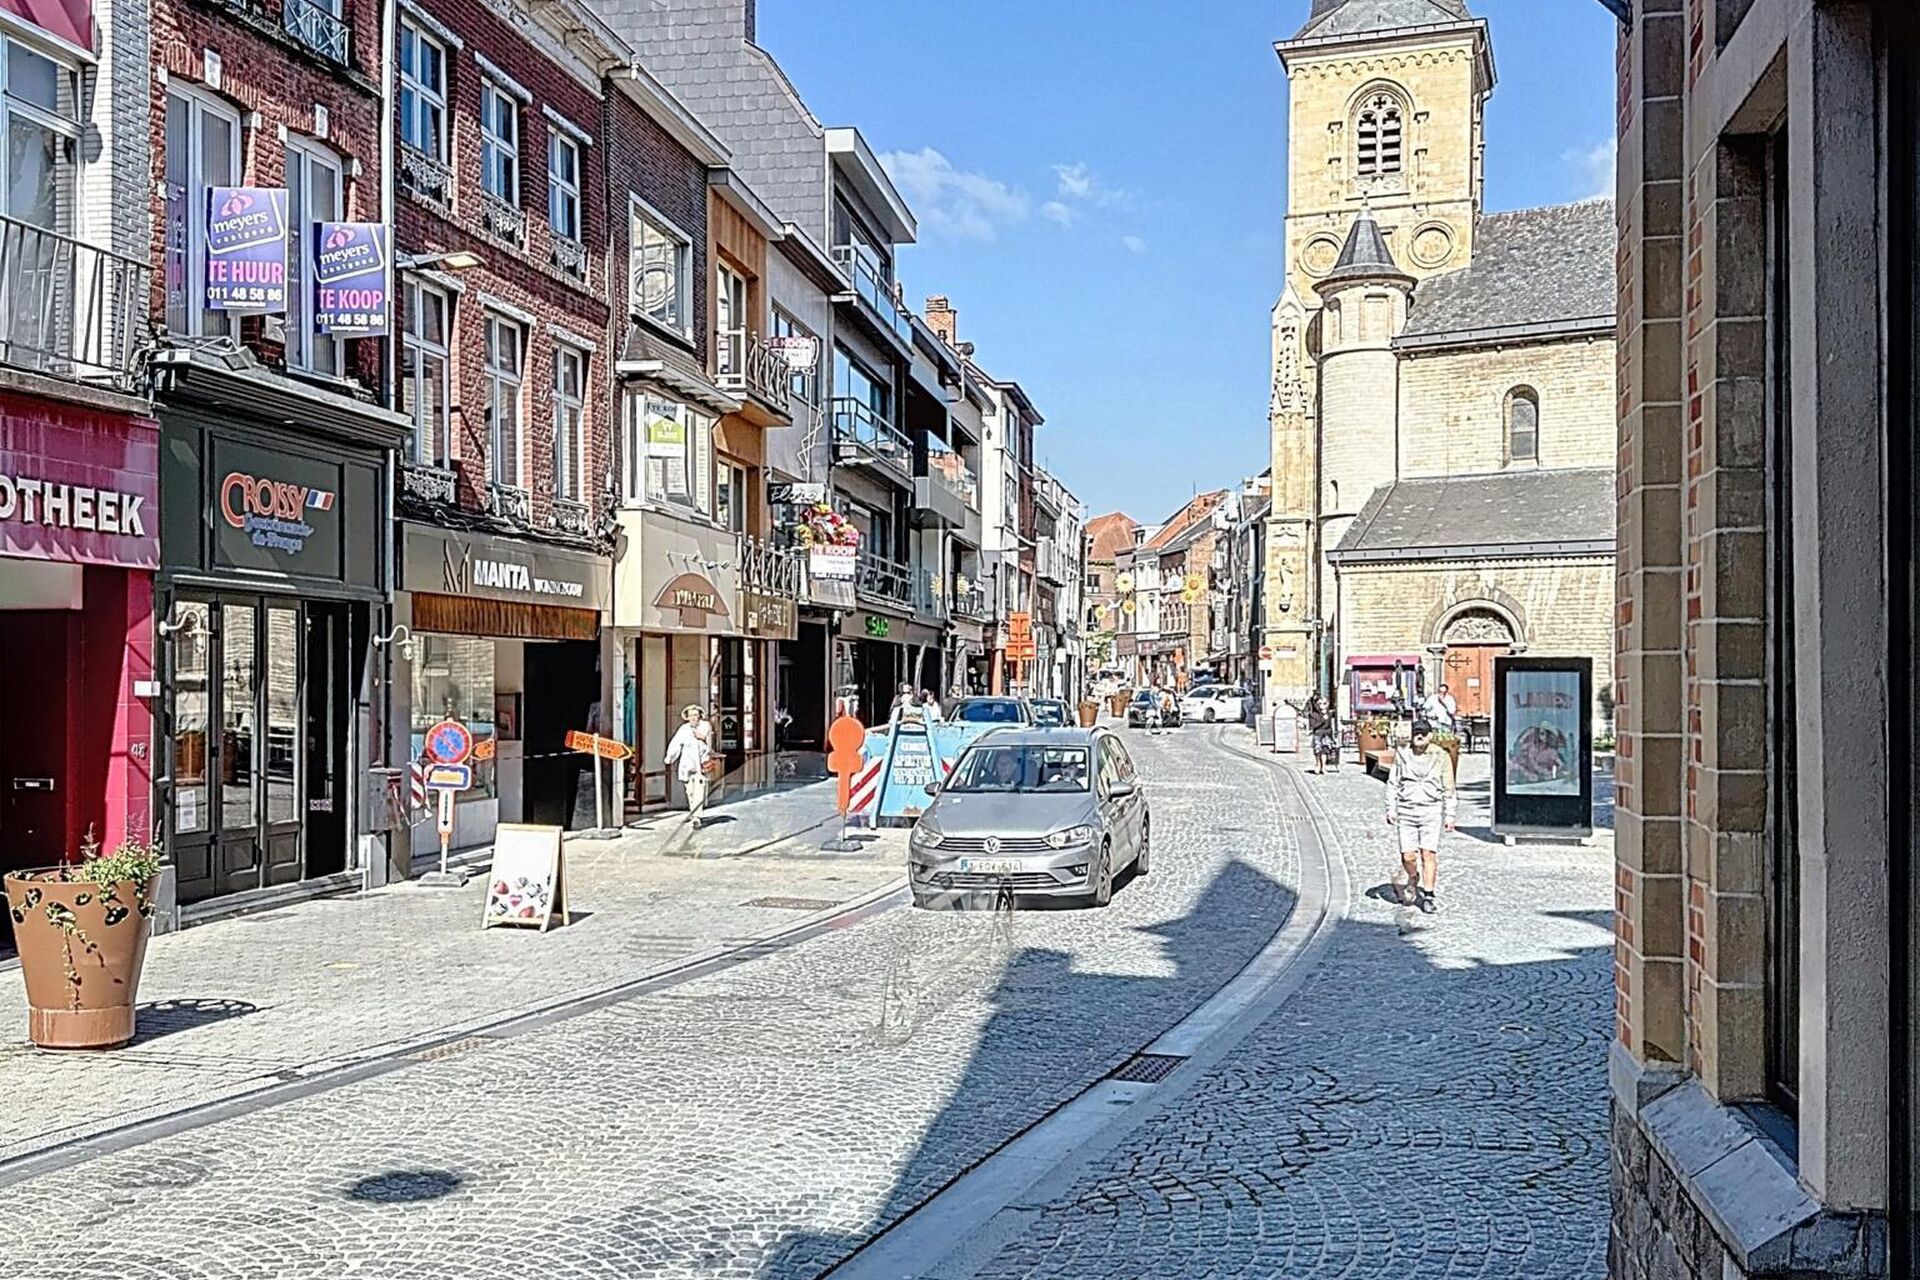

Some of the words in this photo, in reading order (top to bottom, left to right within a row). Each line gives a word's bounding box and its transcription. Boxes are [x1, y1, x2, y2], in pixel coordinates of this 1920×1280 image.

[214, 211, 269, 233] meyers
[319, 243, 370, 265] meyers
[209, 260, 227, 282] TE
[232, 261, 283, 284] HUUR
[207, 287, 227, 299] 011
[231, 287, 246, 300] 48
[249, 288, 264, 300] 58
[267, 289, 282, 301] 86
[318, 289, 335, 309] TE
[338, 289, 384, 310] KOOP
[316, 314, 334, 325] 011
[337, 314, 351, 325] 48
[353, 314, 368, 326] 58
[221, 472, 308, 528] CROISSY
[474, 560, 530, 591] MANTA
